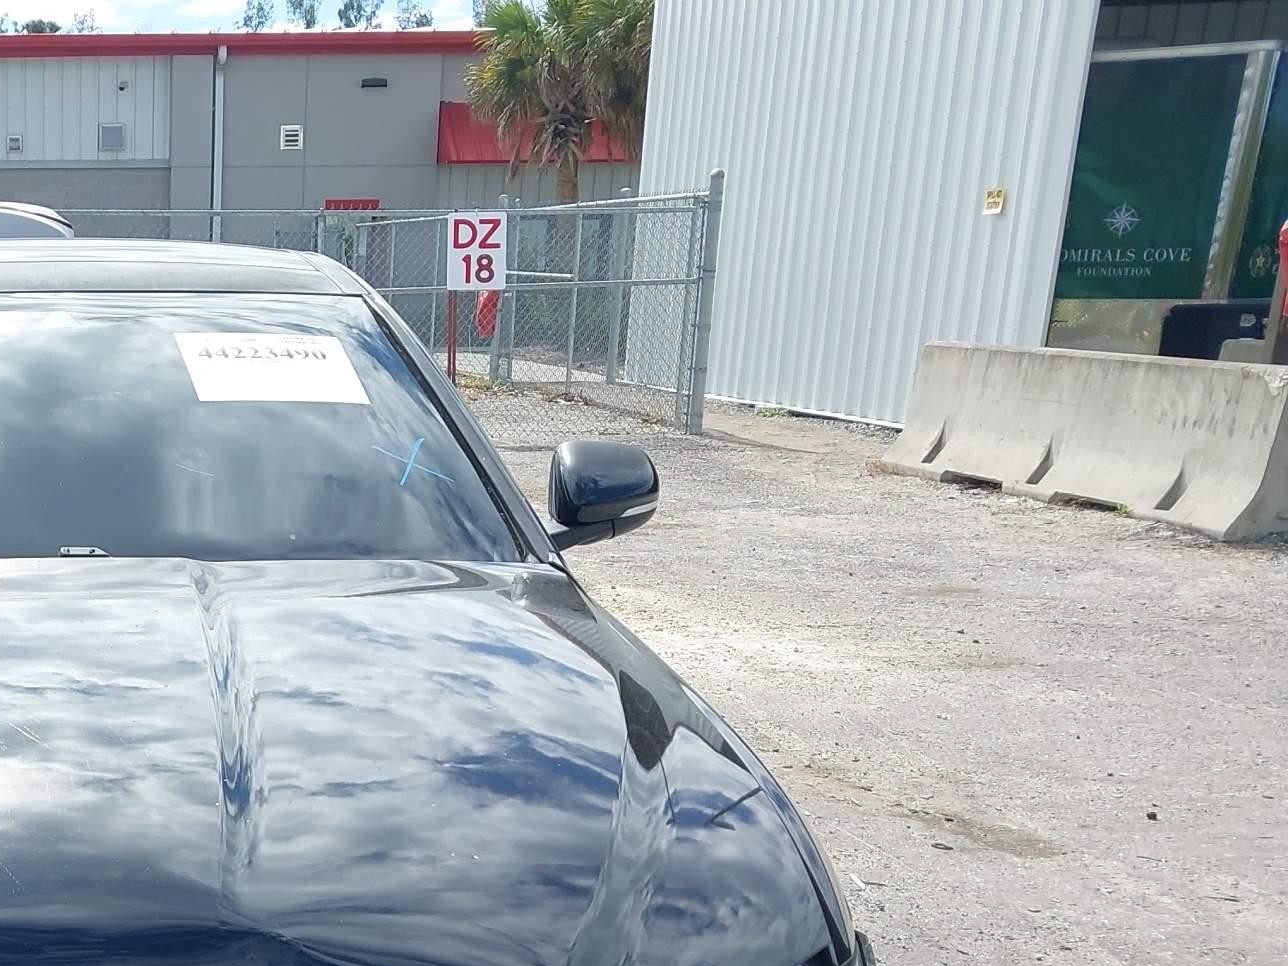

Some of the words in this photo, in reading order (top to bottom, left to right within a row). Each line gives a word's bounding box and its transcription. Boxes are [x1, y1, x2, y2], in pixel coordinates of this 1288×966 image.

[453, 218, 501, 249] DZ
[1060, 248, 1136, 262] DMIRALS
[1143, 247, 1192, 261] COVE
[462, 253, 495, 283] 18
[1076, 267, 1153, 276] FOUNDATION
[198, 345, 327, 361] 44223490
